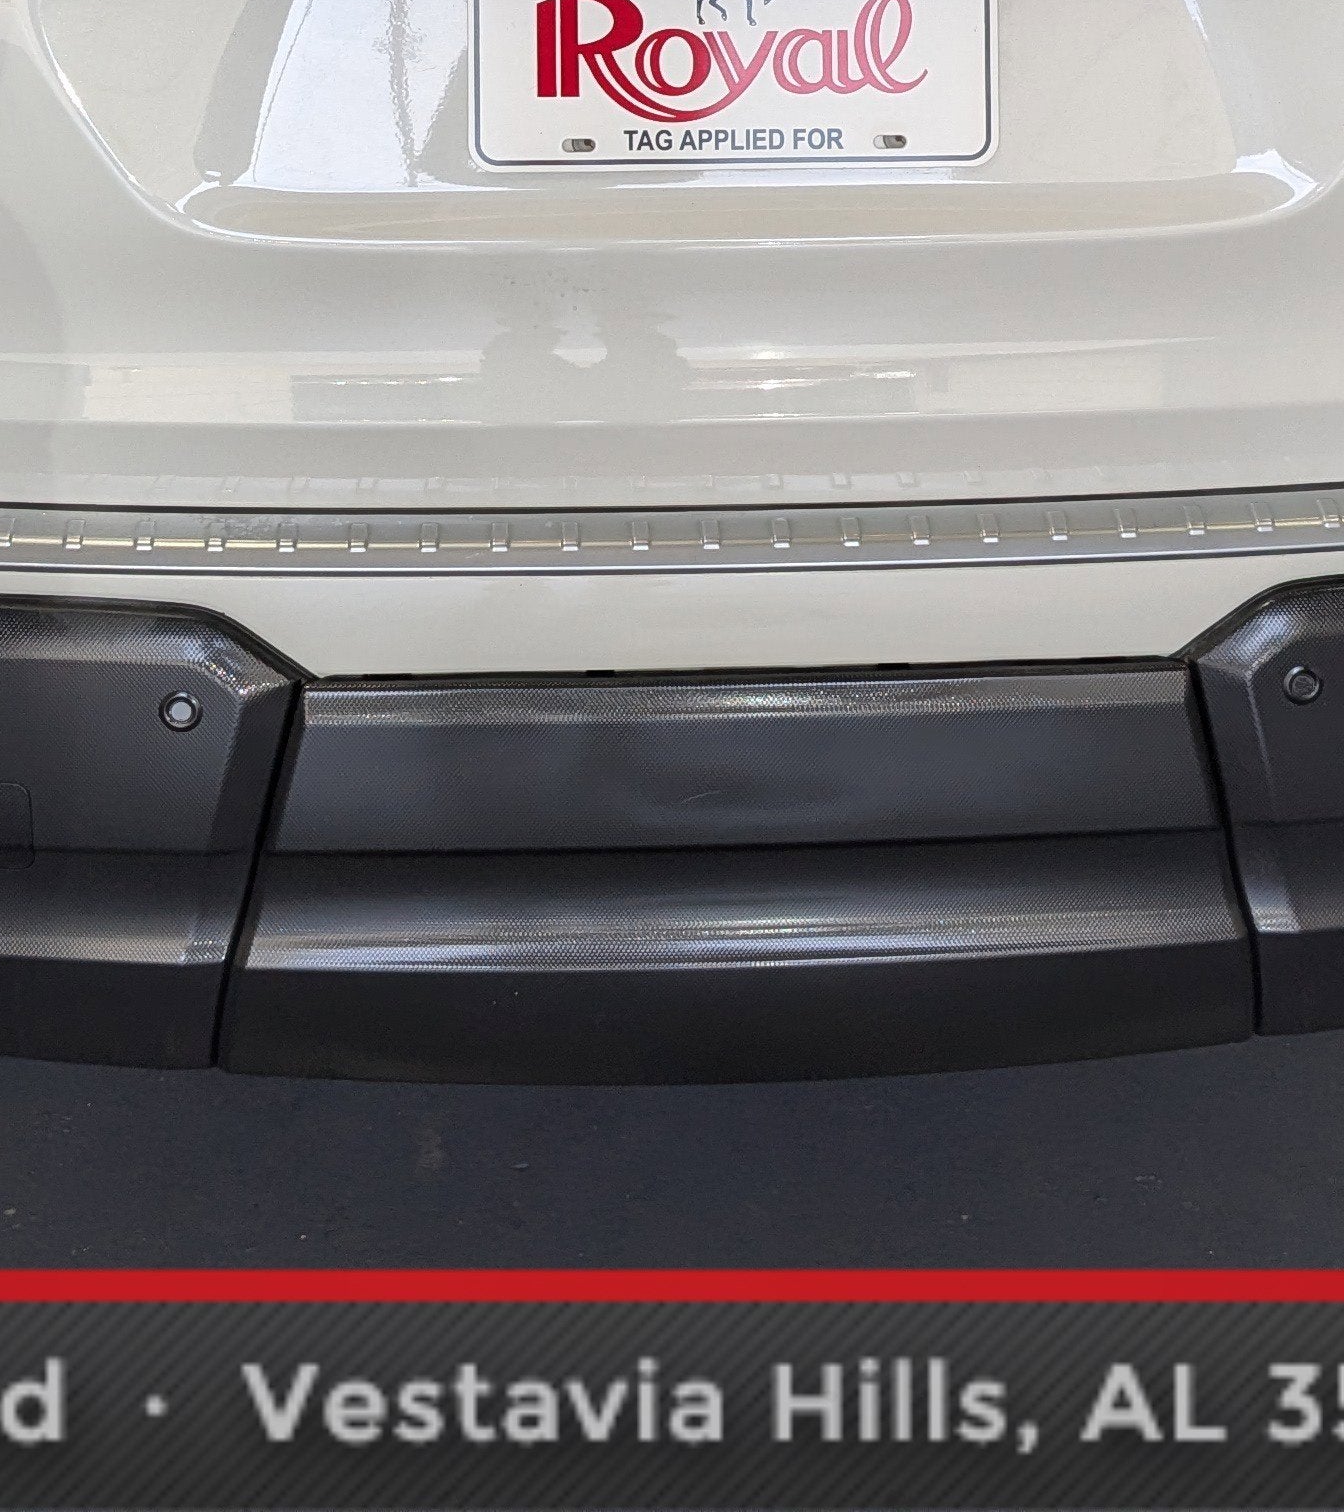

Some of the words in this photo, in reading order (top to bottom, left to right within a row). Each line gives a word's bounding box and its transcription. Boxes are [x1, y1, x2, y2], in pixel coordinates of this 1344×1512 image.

[623, 129, 673, 152] TAG
[679, 128, 785, 151] APPLIED
[792, 128, 844, 151] FOR
